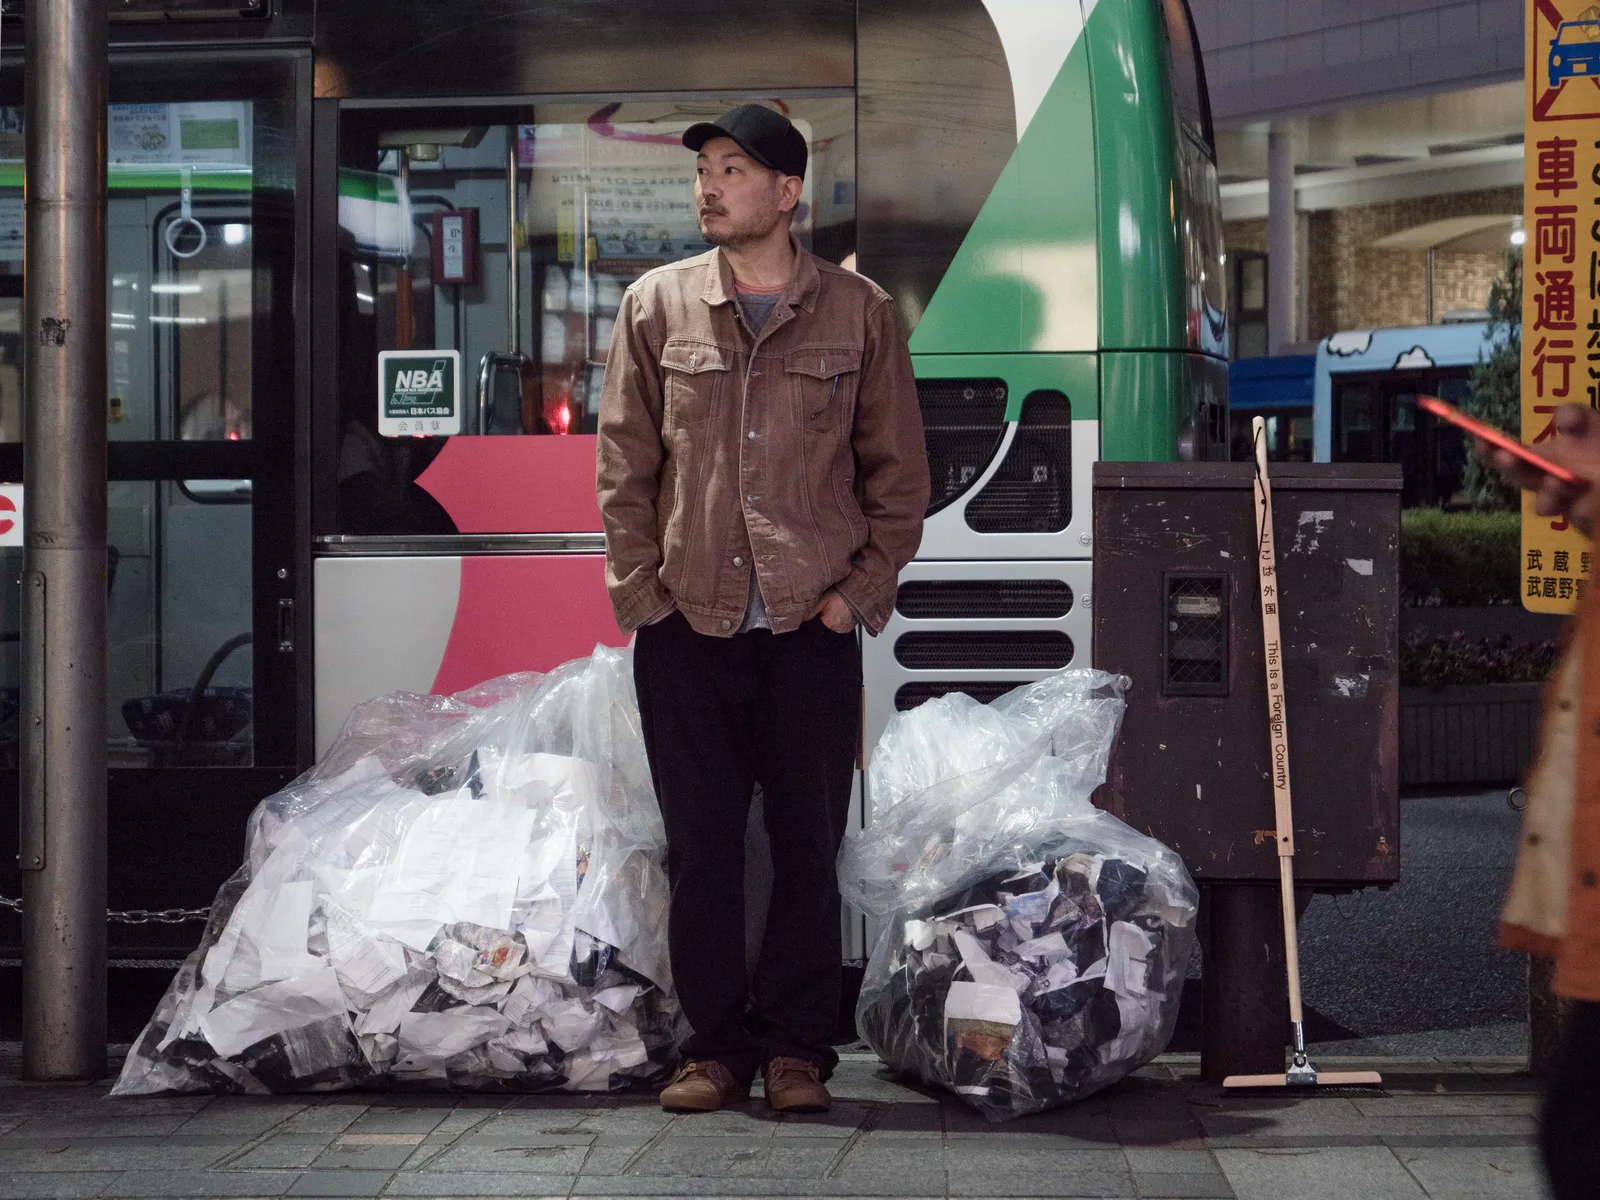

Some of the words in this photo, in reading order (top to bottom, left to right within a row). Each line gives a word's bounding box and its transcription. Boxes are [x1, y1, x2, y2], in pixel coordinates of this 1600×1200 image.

[1532, 136, 1578, 531] 車両通行
[395, 370, 443, 389] NBA
[1261, 533, 1277, 615] ここは外国
[1267, 639, 1279, 665] This
[1269, 668, 1280, 679] Is
[1270, 682, 1279, 690] a
[1271, 694, 1284, 739] Foreign
[1275, 744, 1287, 790] Country
